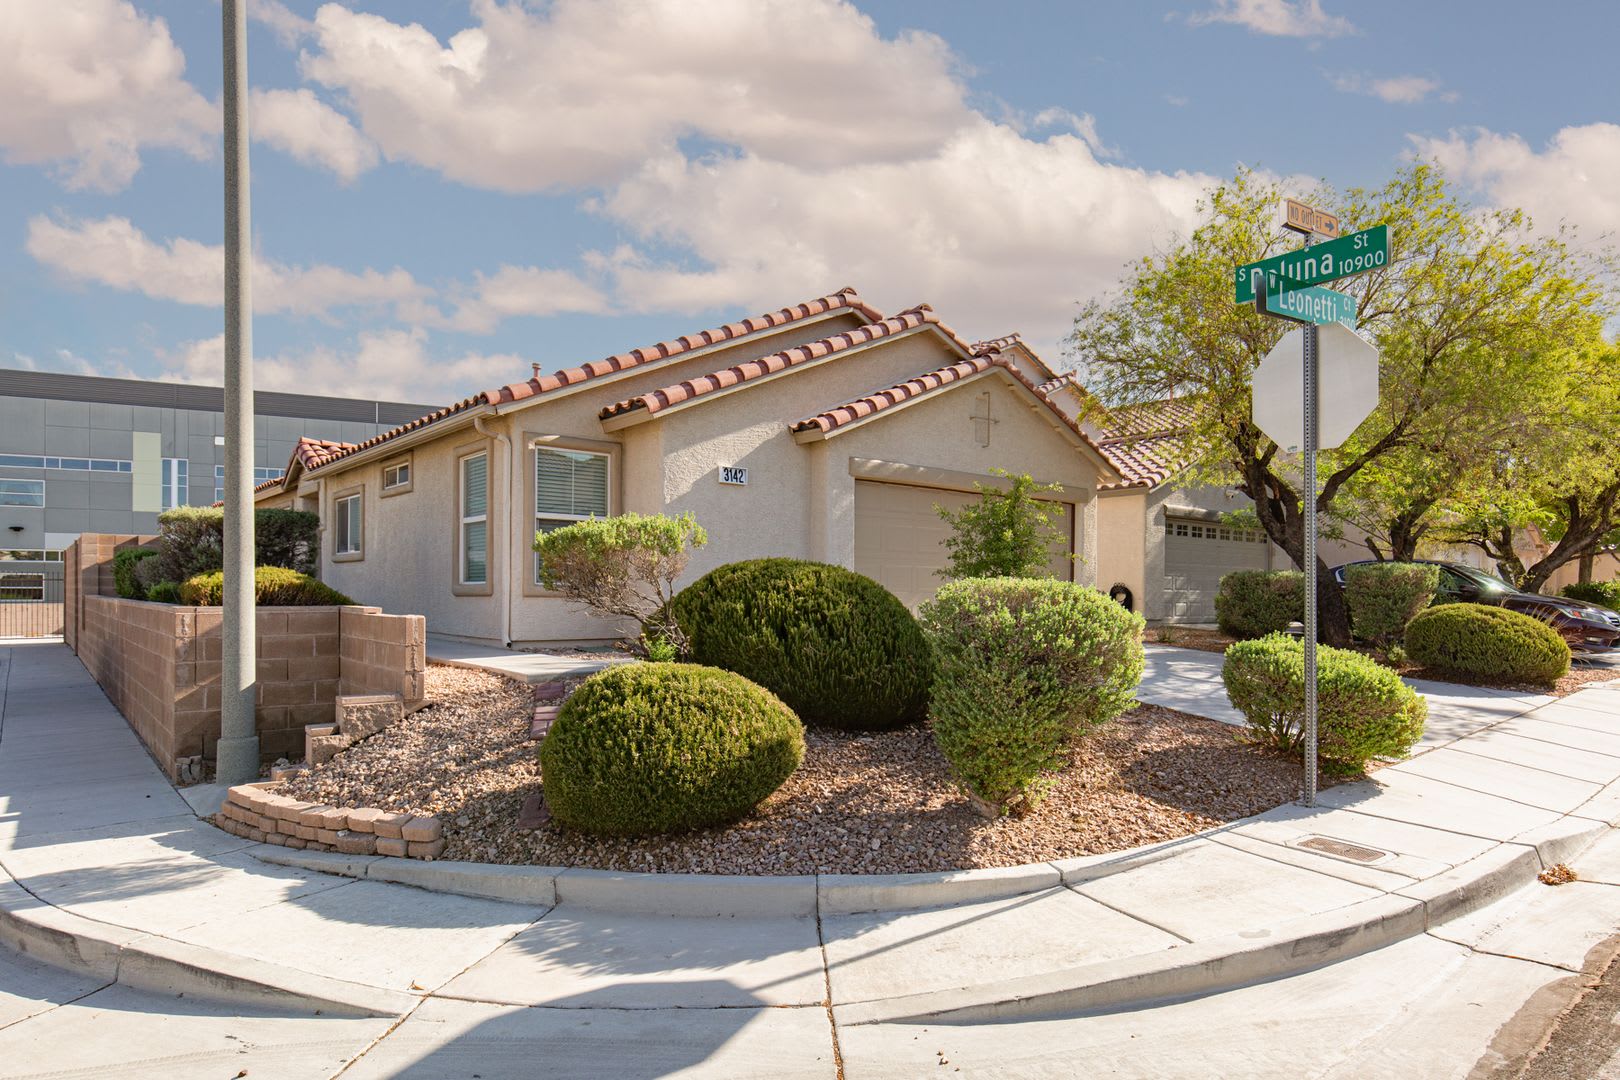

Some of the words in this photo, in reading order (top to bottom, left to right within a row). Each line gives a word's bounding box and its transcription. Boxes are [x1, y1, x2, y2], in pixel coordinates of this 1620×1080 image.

[1290, 206, 1298, 221] NO
[1353, 233, 1369, 249] St
[1339, 250, 1384, 275] 10900
[1238, 267, 1246, 281] S
[1251, 254, 1333, 294] Dluna
[1269, 273, 1276, 288] W
[1279, 280, 1337, 322] Leonetti
[723, 467, 744, 483] 3142
